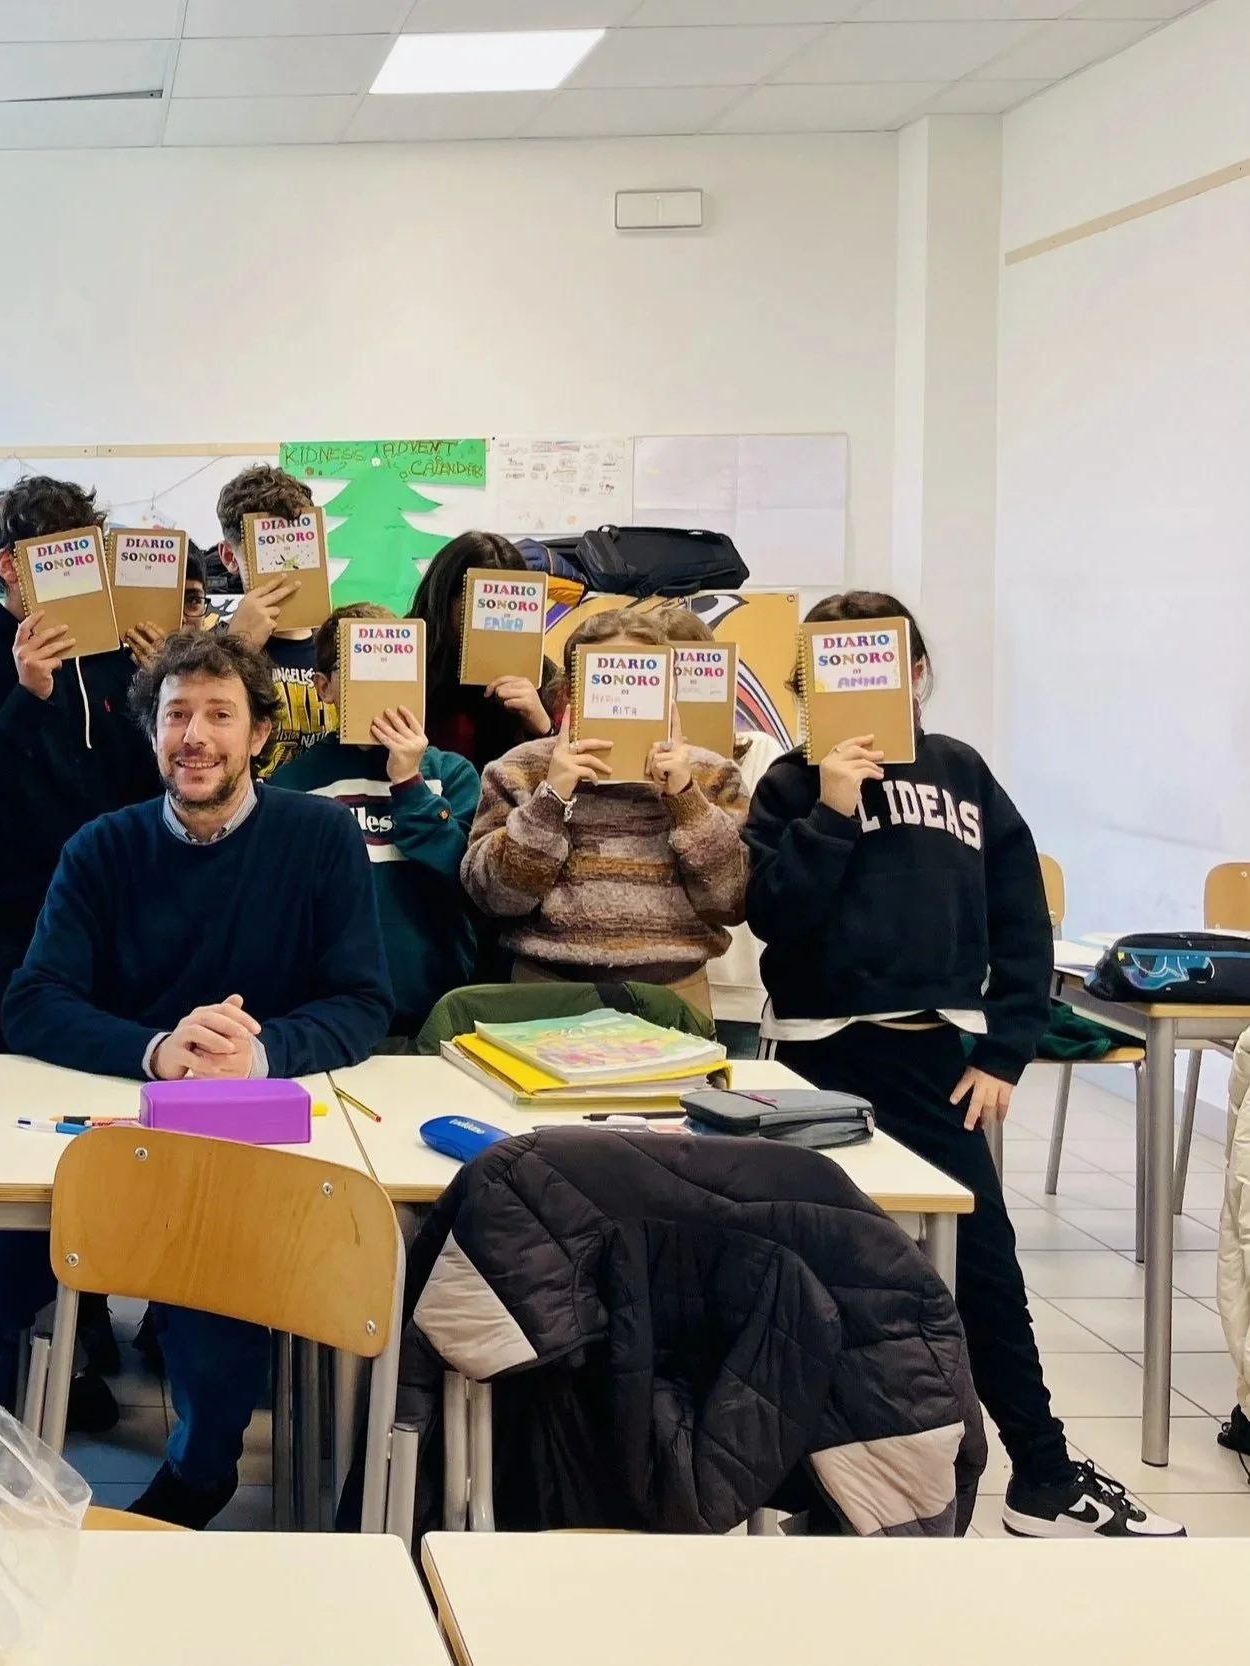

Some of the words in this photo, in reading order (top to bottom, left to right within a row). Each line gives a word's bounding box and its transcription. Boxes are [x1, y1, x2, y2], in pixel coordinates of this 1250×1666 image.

[382, 440, 458, 457] ADVENT
[126, 538, 174, 549] DIARIO
[258, 531, 315, 546] SONORO
[37, 539, 89, 557] DIARIO
[35, 553, 94, 573] SONORO
[121, 552, 176, 563] SONORO
[483, 583, 537, 597] DIARIO
[478, 598, 539, 612] SONORO
[359, 628, 411, 639] DIARIO
[354, 643, 414, 654] SONORO
[823, 634, 890, 649] DIARIO
[597, 657, 658, 671] DIARIO
[818, 651, 895, 667] SONORO
[673, 667, 724, 678] ONORO
[591, 674, 660, 687] SONORO
[837, 675, 888, 689] ANNA
[612, 705, 638, 717] RITA
[882, 780, 982, 851] IDEAS
